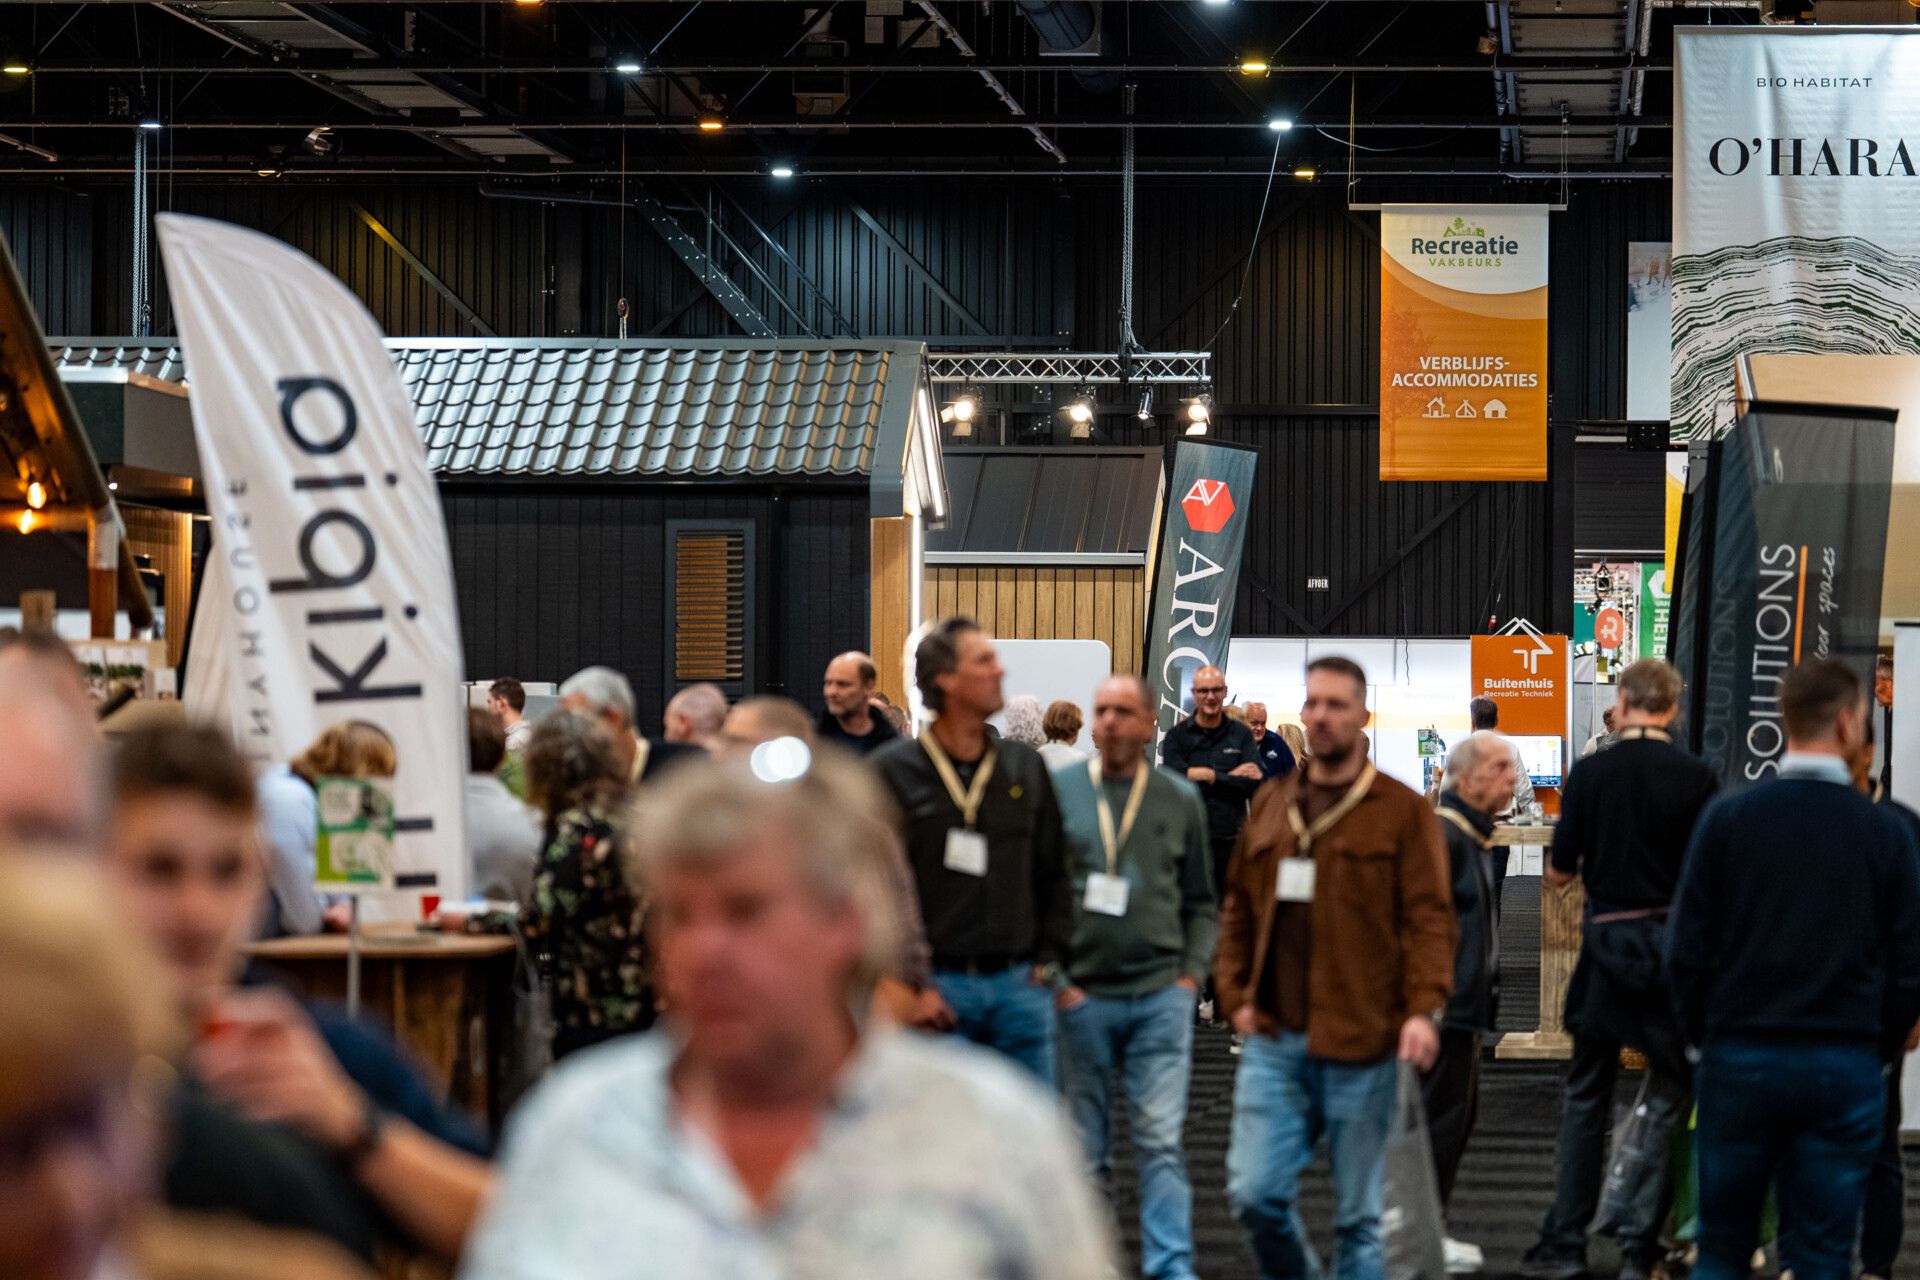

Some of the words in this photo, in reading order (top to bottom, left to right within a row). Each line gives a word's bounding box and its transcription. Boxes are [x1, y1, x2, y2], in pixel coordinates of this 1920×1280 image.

[1756, 77, 1788, 88] BIO
[1793, 77, 1873, 88] HABITAT
[1708, 136, 1920, 177] O'HARA
[1411, 235, 1519, 256] Recreatie
[1428, 258, 1502, 267] VAKBEURS
[1419, 356, 1510, 371] VERBLIJFS-
[1392, 373, 1538, 387] ACCOMMODATIES
[1307, 578, 1329, 589] AFVOER
[1818, 546, 1839, 615] spaces
[1483, 677, 1554, 689] Buitenhuis
